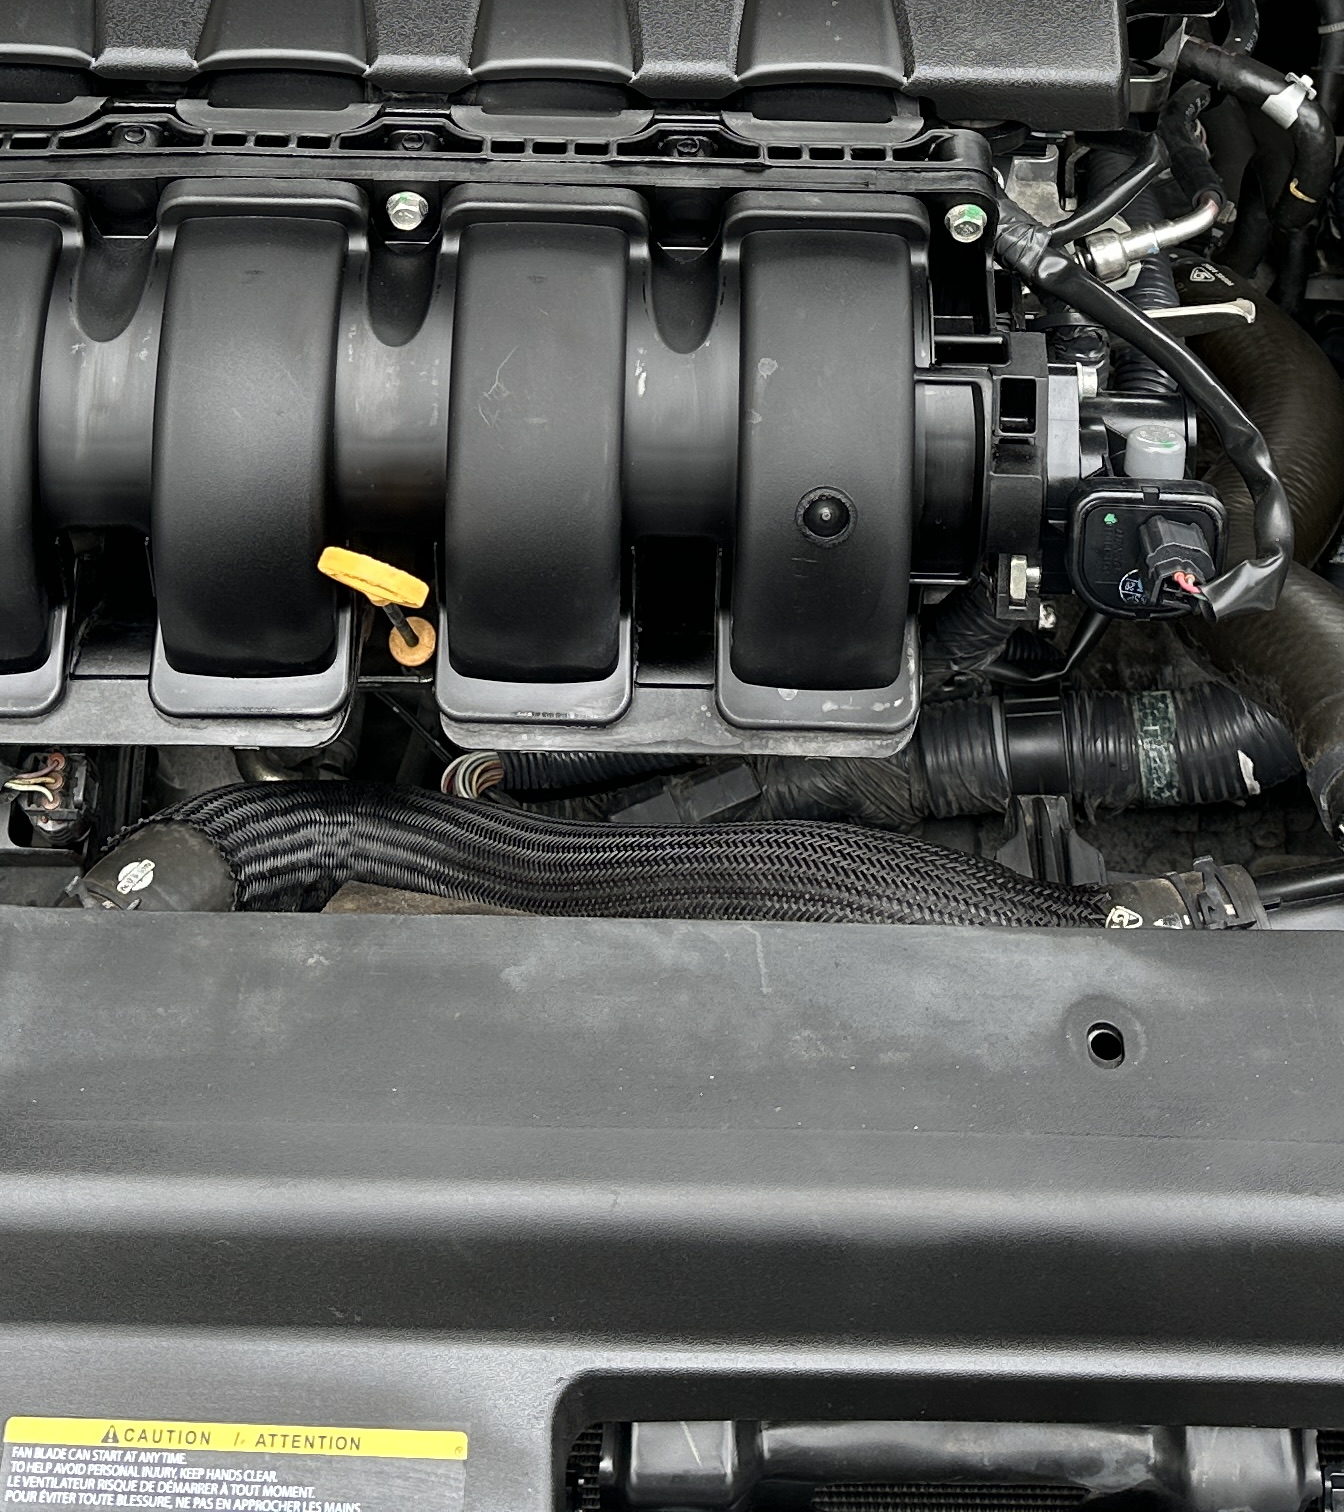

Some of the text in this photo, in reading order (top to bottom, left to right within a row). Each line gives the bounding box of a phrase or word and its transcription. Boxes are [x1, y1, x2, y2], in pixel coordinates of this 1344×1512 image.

[123, 1428, 211, 1445] CAUTION
[255, 1433, 362, 1451] ATTENTION
[12, 1446, 32, 1459] FAN
[34, 1447, 68, 1460] BLADE
[68, 1448, 91, 1461] CAN
[92, 1449, 123, 1462] START
[123, 1450, 138, 1462] AT
[10, 1460, 278, 1483] TO HELP AVOID PERSONAL INJURY, KEEP HANDS CLEAR.
[7, 1476, 21, 1488] LE
[22, 1476, 96, 1491] VENTILATEUR
[97, 1479, 139, 1493] RISQUE
[140, 1481, 157, 1494] DE
[157, 1480, 219, 1495] DÉMARRER
[230, 1484, 261, 1497] TOUT
[261, 1486, 316, 1499] MOMENT.
[4, 1490, 37, 1503] POUR
[38, 1489, 77, 1505] ÉVITER
[78, 1492, 114, 1506] TOUTE
[115, 1494, 174, 1510] BLESSURE,
[175, 1496, 191, 1509] NE
[192, 1497, 214, 1510] PAS
[215, 1498, 231, 1511] EN
[233, 1499, 301, 1512] APPROCHER
[303, 1501, 322, 1512] LES
